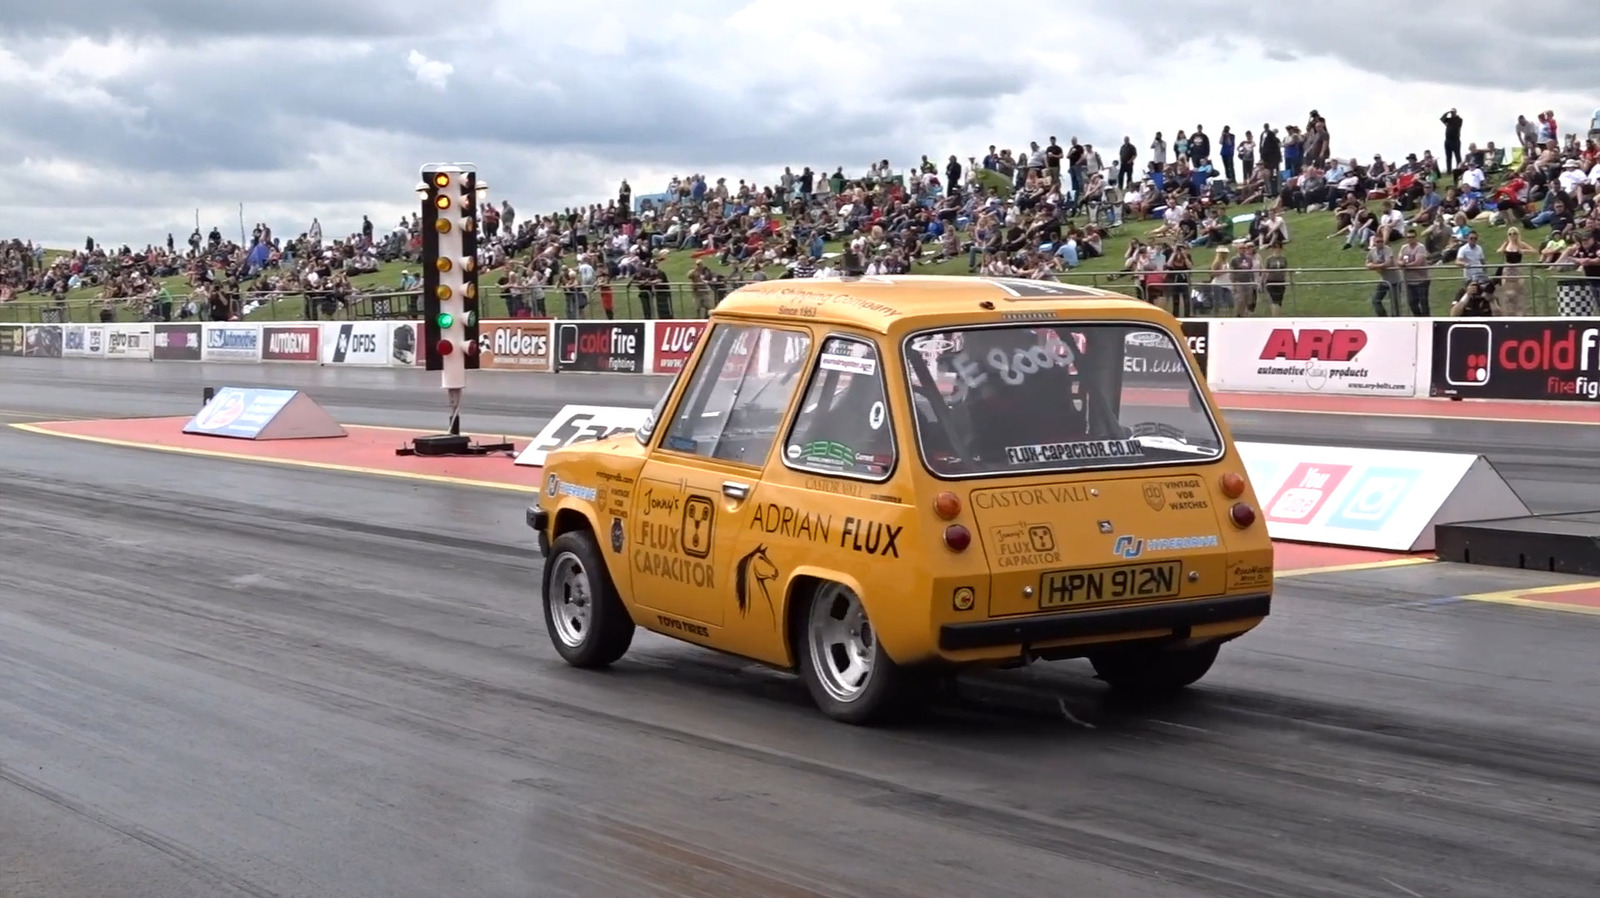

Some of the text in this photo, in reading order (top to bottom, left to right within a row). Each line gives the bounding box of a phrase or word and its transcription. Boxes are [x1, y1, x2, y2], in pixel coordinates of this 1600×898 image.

[778, 305, 799, 315] Since
[832, 294, 904, 316] Company
[269, 332, 310, 353] AUTOGLYM
[352, 333, 376, 353] DFDS
[494, 327, 547, 356] Alders
[580, 327, 636, 354] coldfire
[1259, 328, 1368, 361] ARP
[1257, 366, 1305, 376] automotive
[1329, 367, 1368, 379] products
[1164, 479, 1201, 489] VINTAGE
[1299, 466, 1331, 489] You
[644, 488, 680, 517] Jonny's
[976, 486, 1089, 509] CASTOR VALI
[1168, 500, 1209, 511] WATCHES
[1175, 491, 1195, 500] VDB
[639, 520, 681, 554] FLUX
[750, 503, 903, 559] ADRIAN FLUX
[1000, 542, 1032, 556] FLUX
[1146, 535, 1219, 552] HYPERDRIVE
[633, 548, 716, 590] CAPACITOR
[998, 551, 1062, 567] CAPACITOR
[1049, 565, 1174, 603] HPN 912N
[656, 615, 710, 637] TOYO TIRES
